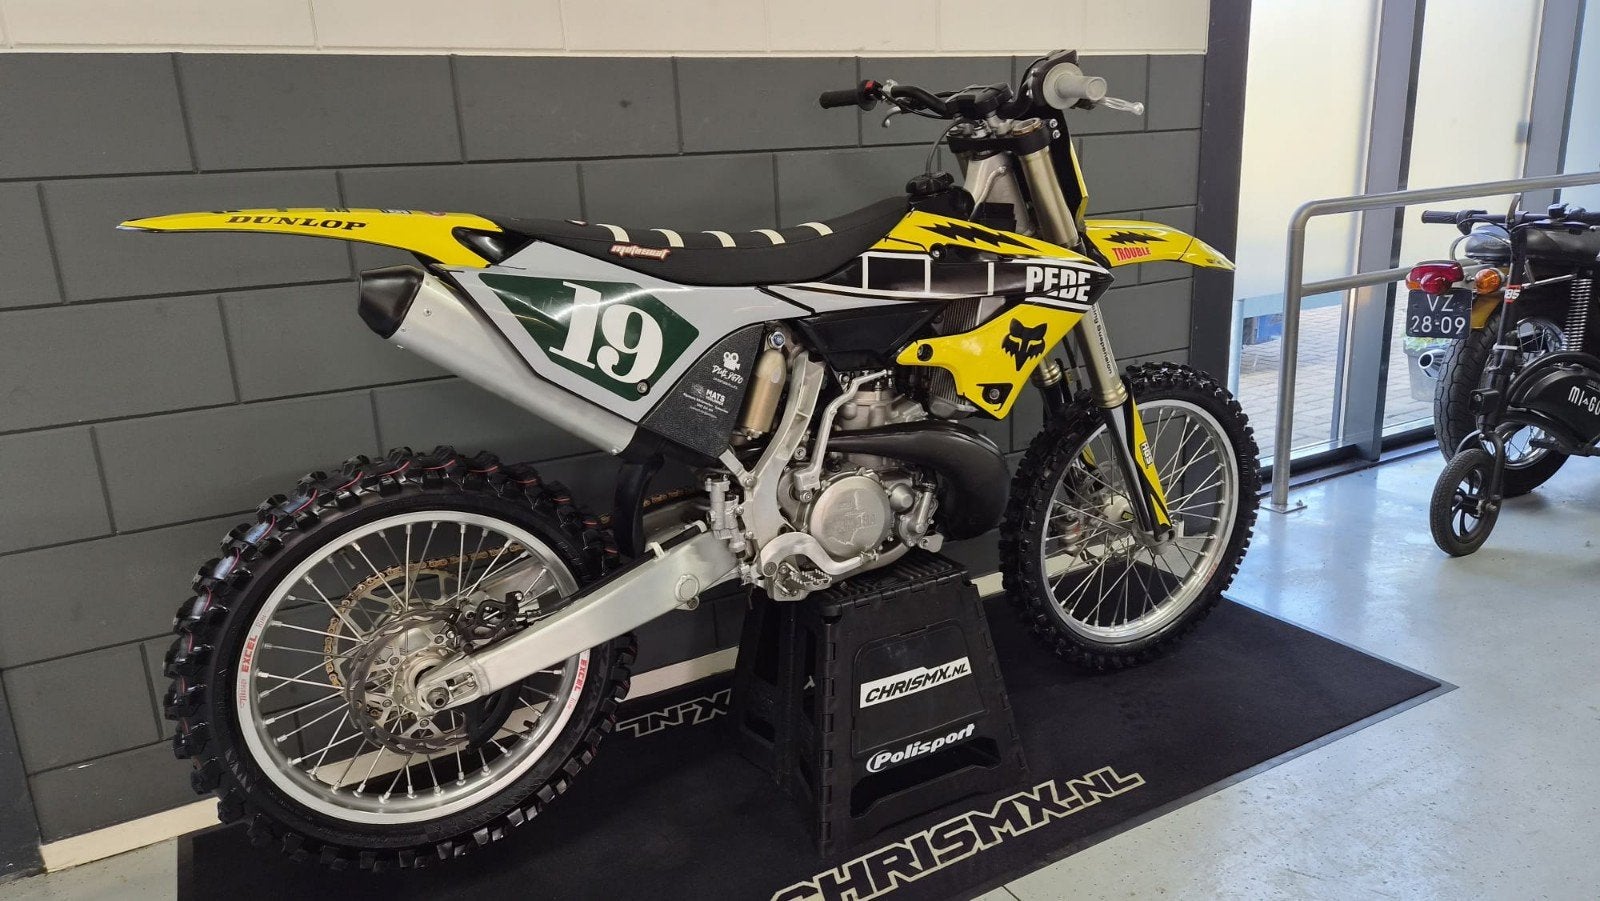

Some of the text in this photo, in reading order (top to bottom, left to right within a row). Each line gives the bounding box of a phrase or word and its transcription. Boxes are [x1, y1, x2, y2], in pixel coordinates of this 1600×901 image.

[228, 215, 367, 230] DUNLOP
[1112, 246, 1152, 262] TROUBLE
[1427, 294, 1454, 312] VZ
[549, 281, 663, 384] 19
[1411, 316, 1466, 335] 28-09
[705, 389, 726, 402] MATS
[241, 634, 258, 673] EXCEL
[574, 658, 588, 692] EXCEL
[865, 662, 969, 703] CHRISMX.NL
[866, 723, 975, 772] Polisport
